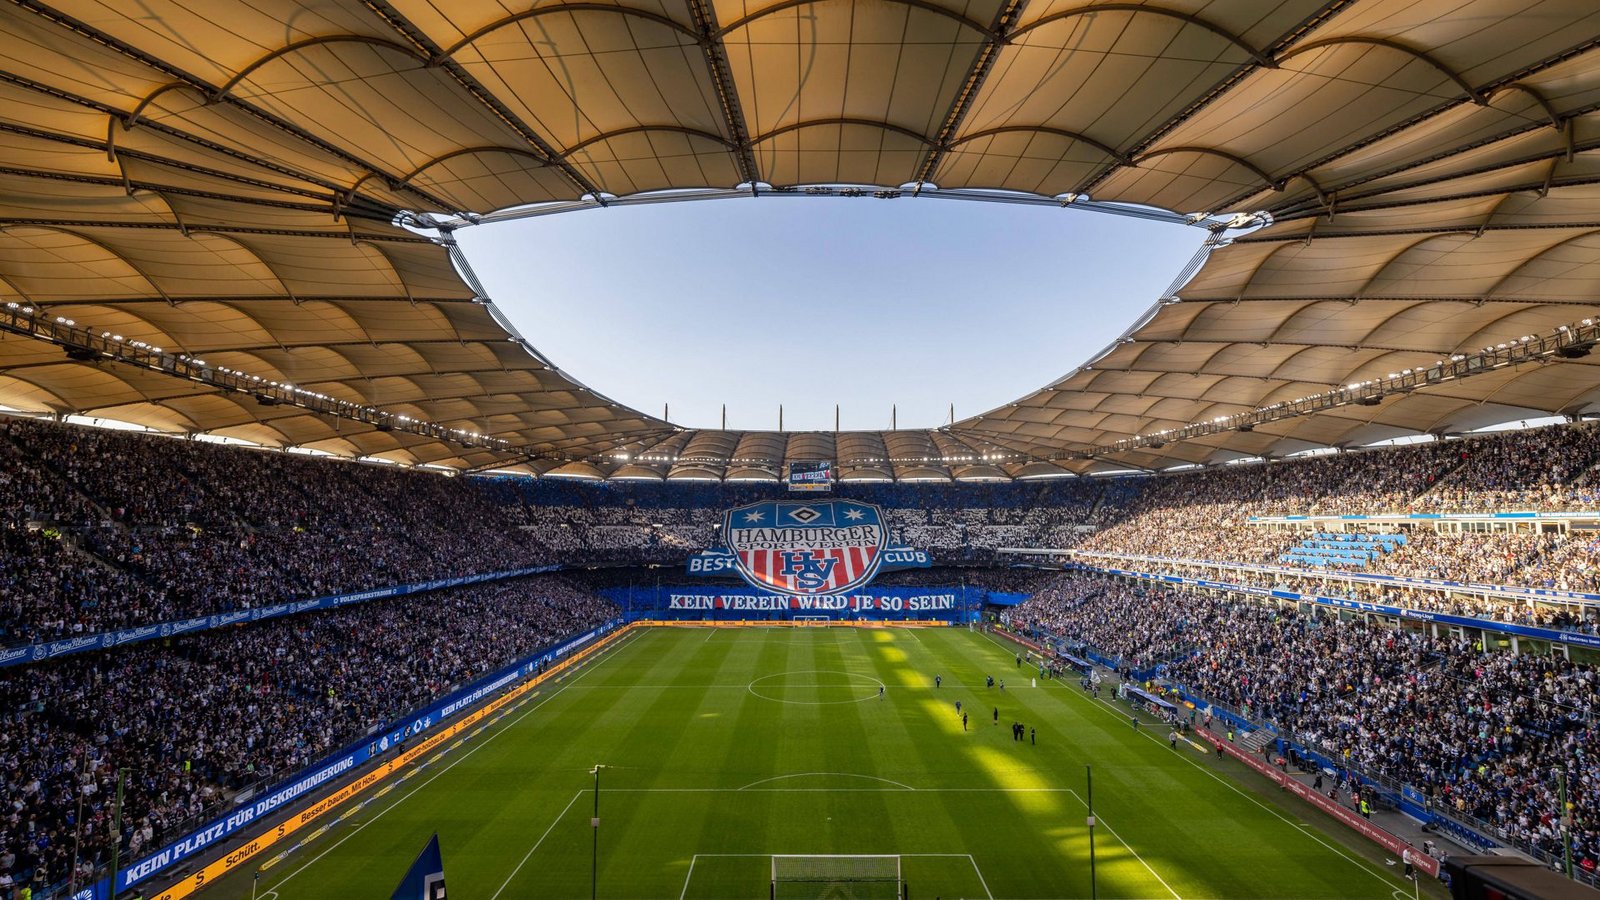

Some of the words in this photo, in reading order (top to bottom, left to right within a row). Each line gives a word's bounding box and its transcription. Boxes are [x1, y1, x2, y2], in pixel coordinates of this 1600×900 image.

[737, 526, 877, 544] HAMBURGER
[690, 557, 737, 572] BEST
[884, 550, 928, 563] CLUB
[669, 594, 714, 610] KEIN
[721, 594, 790, 610] VEREIN
[797, 594, 848, 610] WIRD
[852, 594, 875, 612] JE
[880, 595, 903, 611] SO
[909, 594, 954, 610] SEIN!
[301, 801, 327, 823] Besser
[351, 780, 362, 792] Mit
[125, 850, 171, 886] KEIN
[173, 826, 224, 860] PLATZ
[226, 809, 255, 832] FÜR
[256, 756, 354, 816] DISKRIMINIERUNG
[225, 842, 261, 868] Schütt.
[195, 871, 205, 889] S
